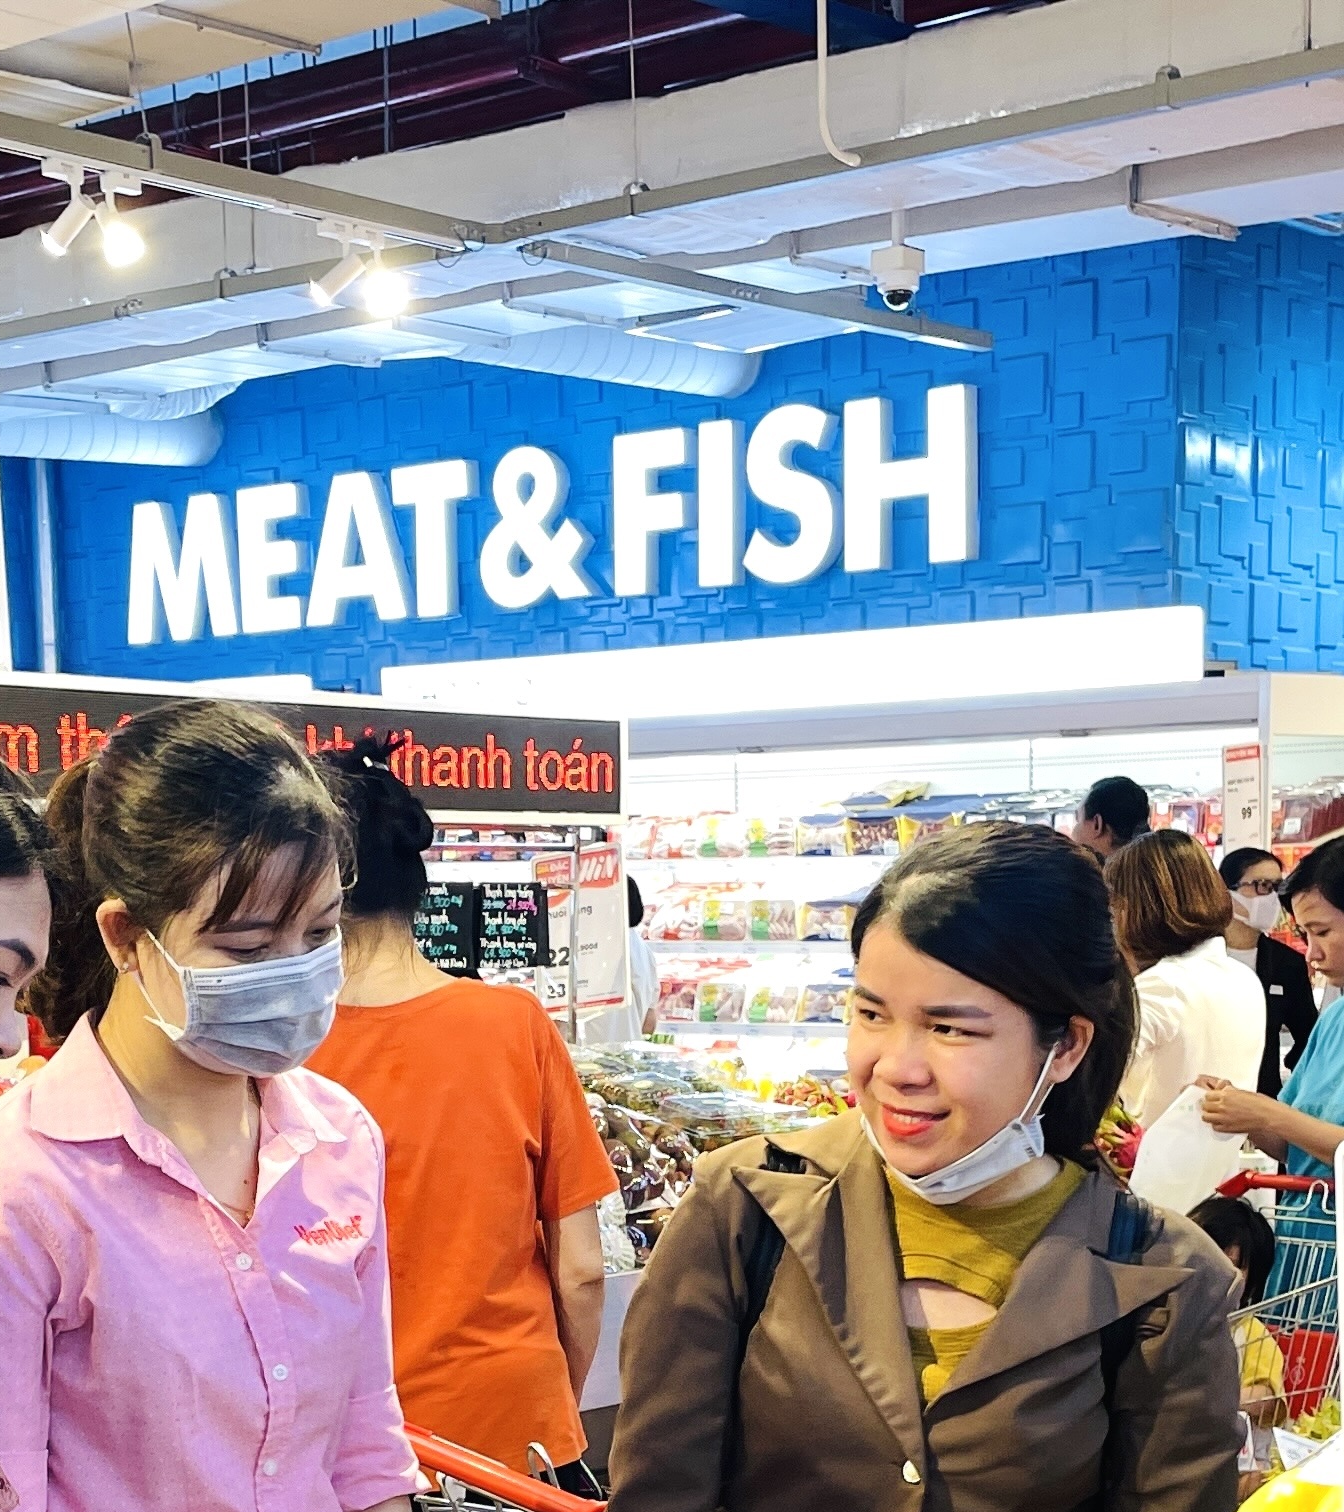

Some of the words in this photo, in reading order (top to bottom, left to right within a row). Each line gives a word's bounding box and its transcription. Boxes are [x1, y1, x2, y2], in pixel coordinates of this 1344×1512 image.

[126, 457, 479, 646] MEAT
[613, 383, 978, 598] FISH
[523, 737, 614, 793] toán
